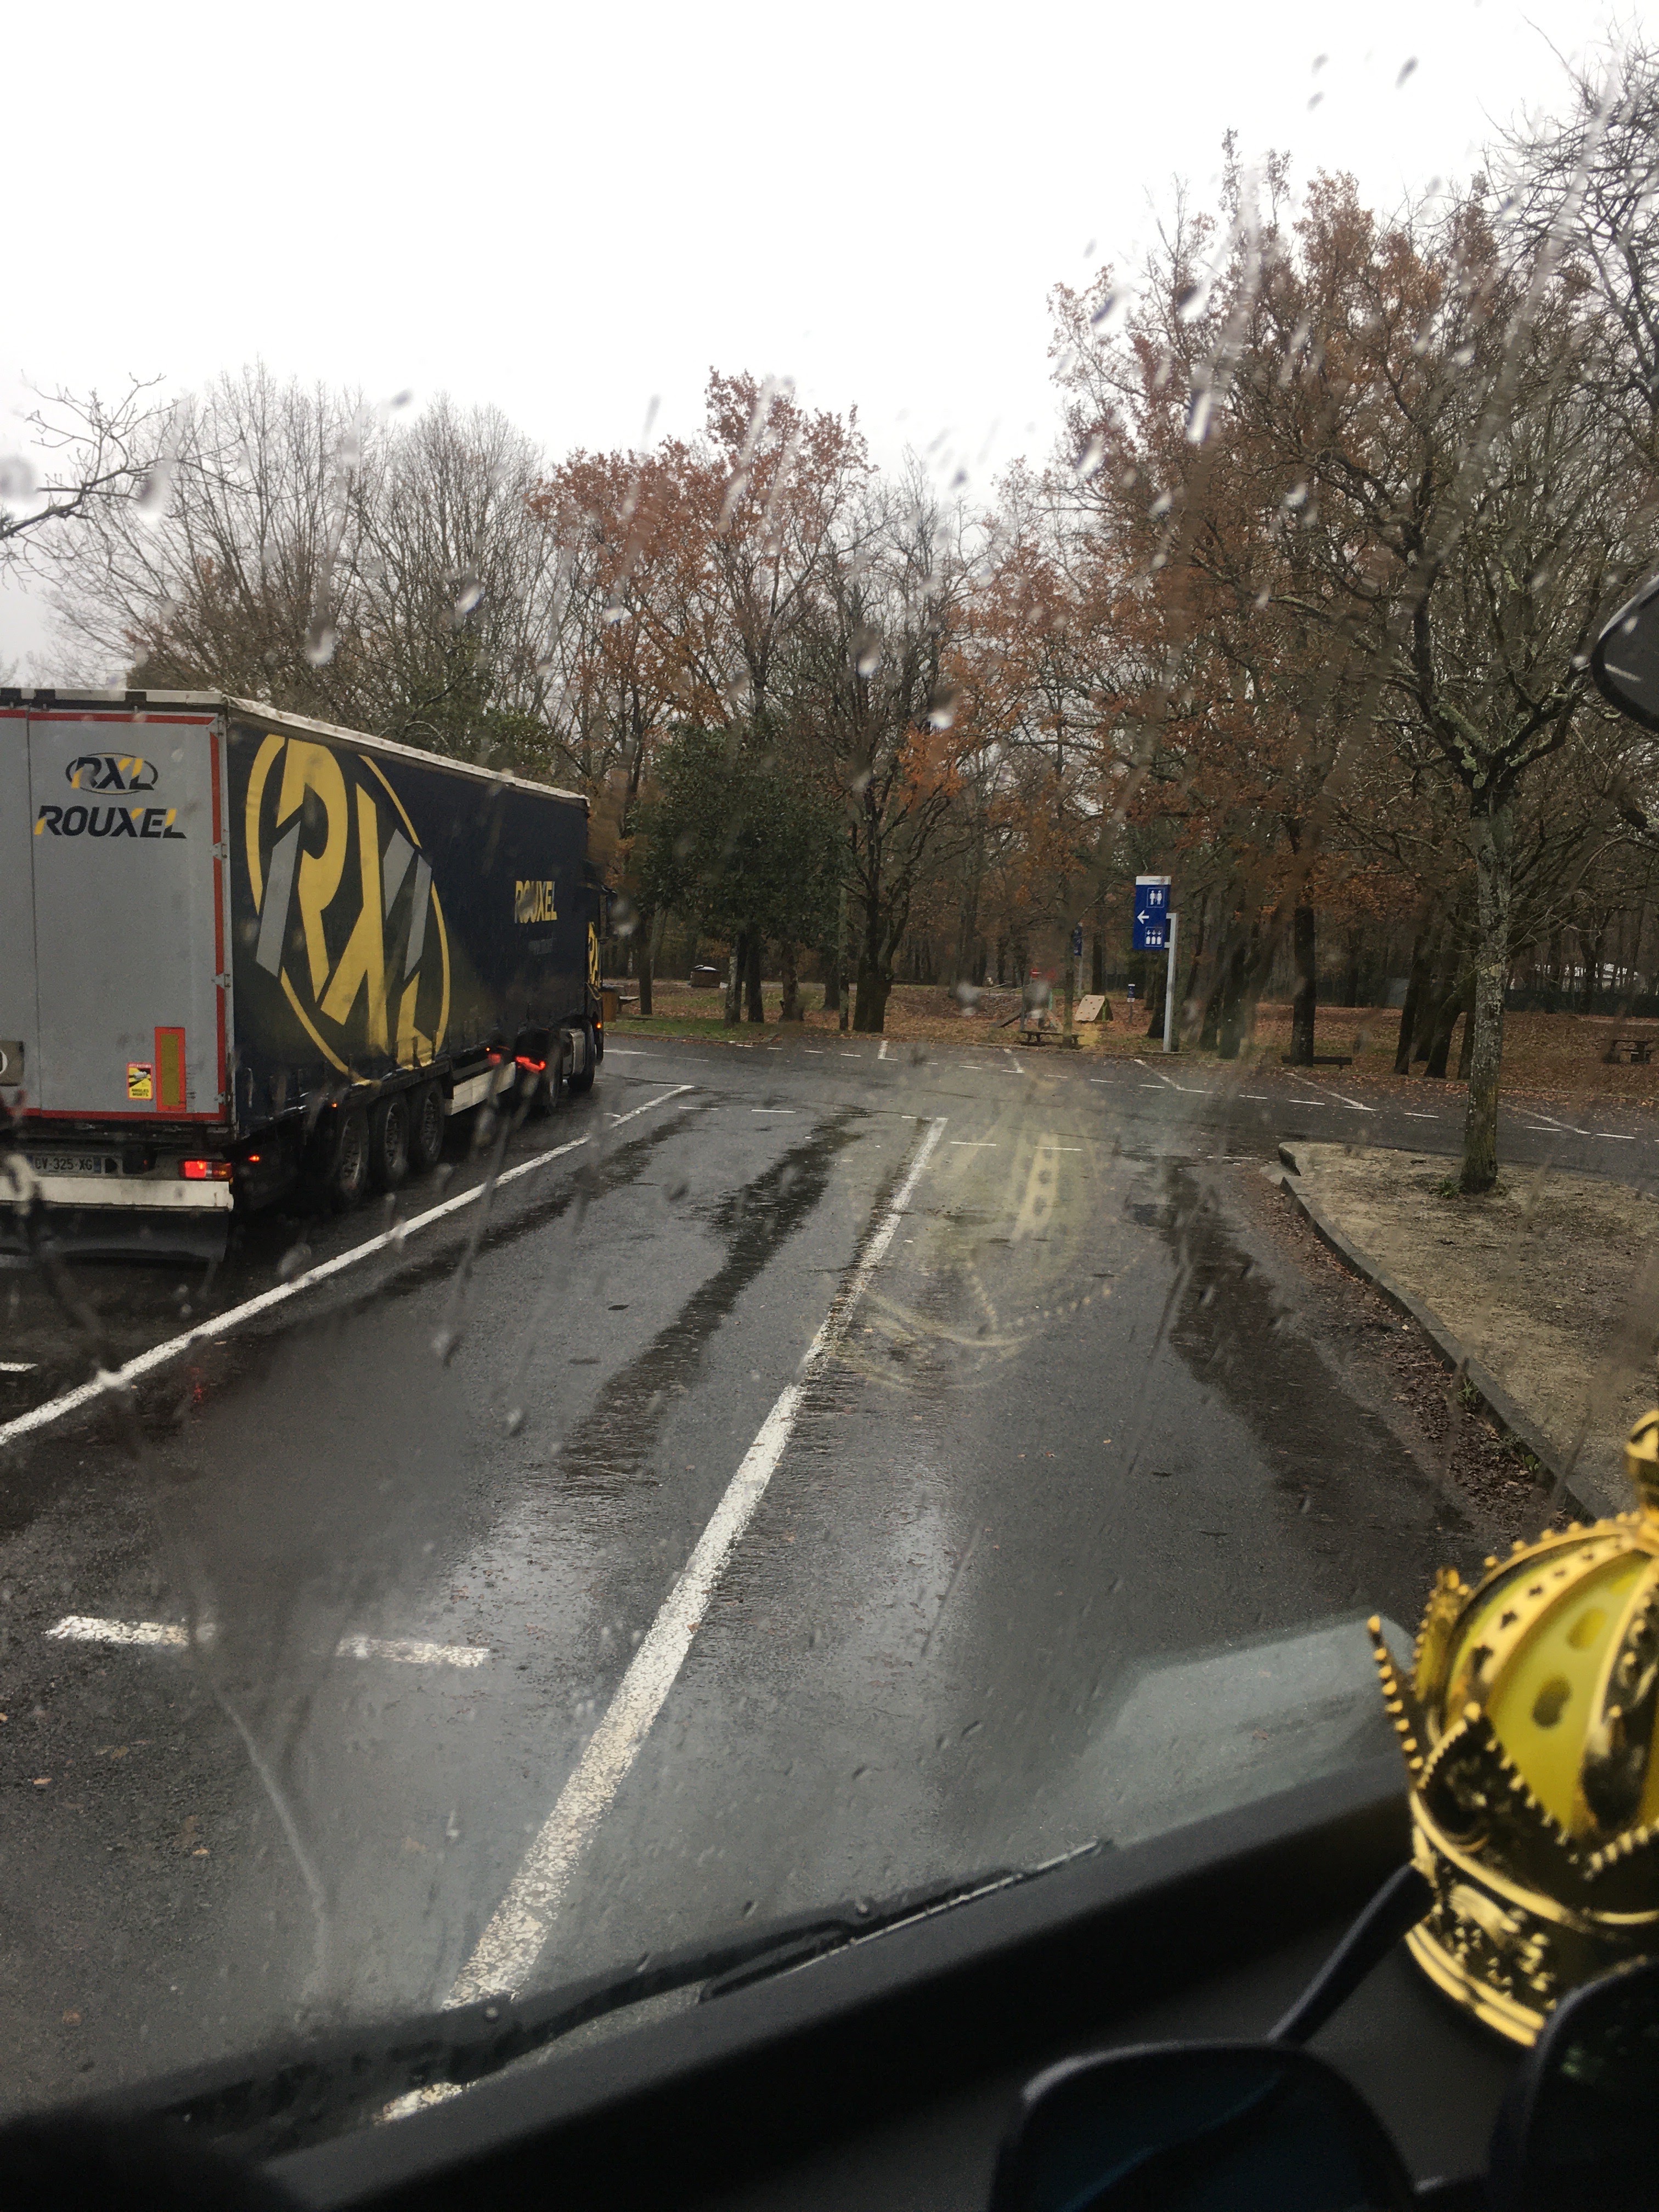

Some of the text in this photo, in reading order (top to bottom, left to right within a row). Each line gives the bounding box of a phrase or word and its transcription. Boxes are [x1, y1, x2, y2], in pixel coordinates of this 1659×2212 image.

[71, 757, 155, 791] RXL
[34, 805, 187, 839] ROUXEL
[515, 880, 557, 924] ROUXEL
